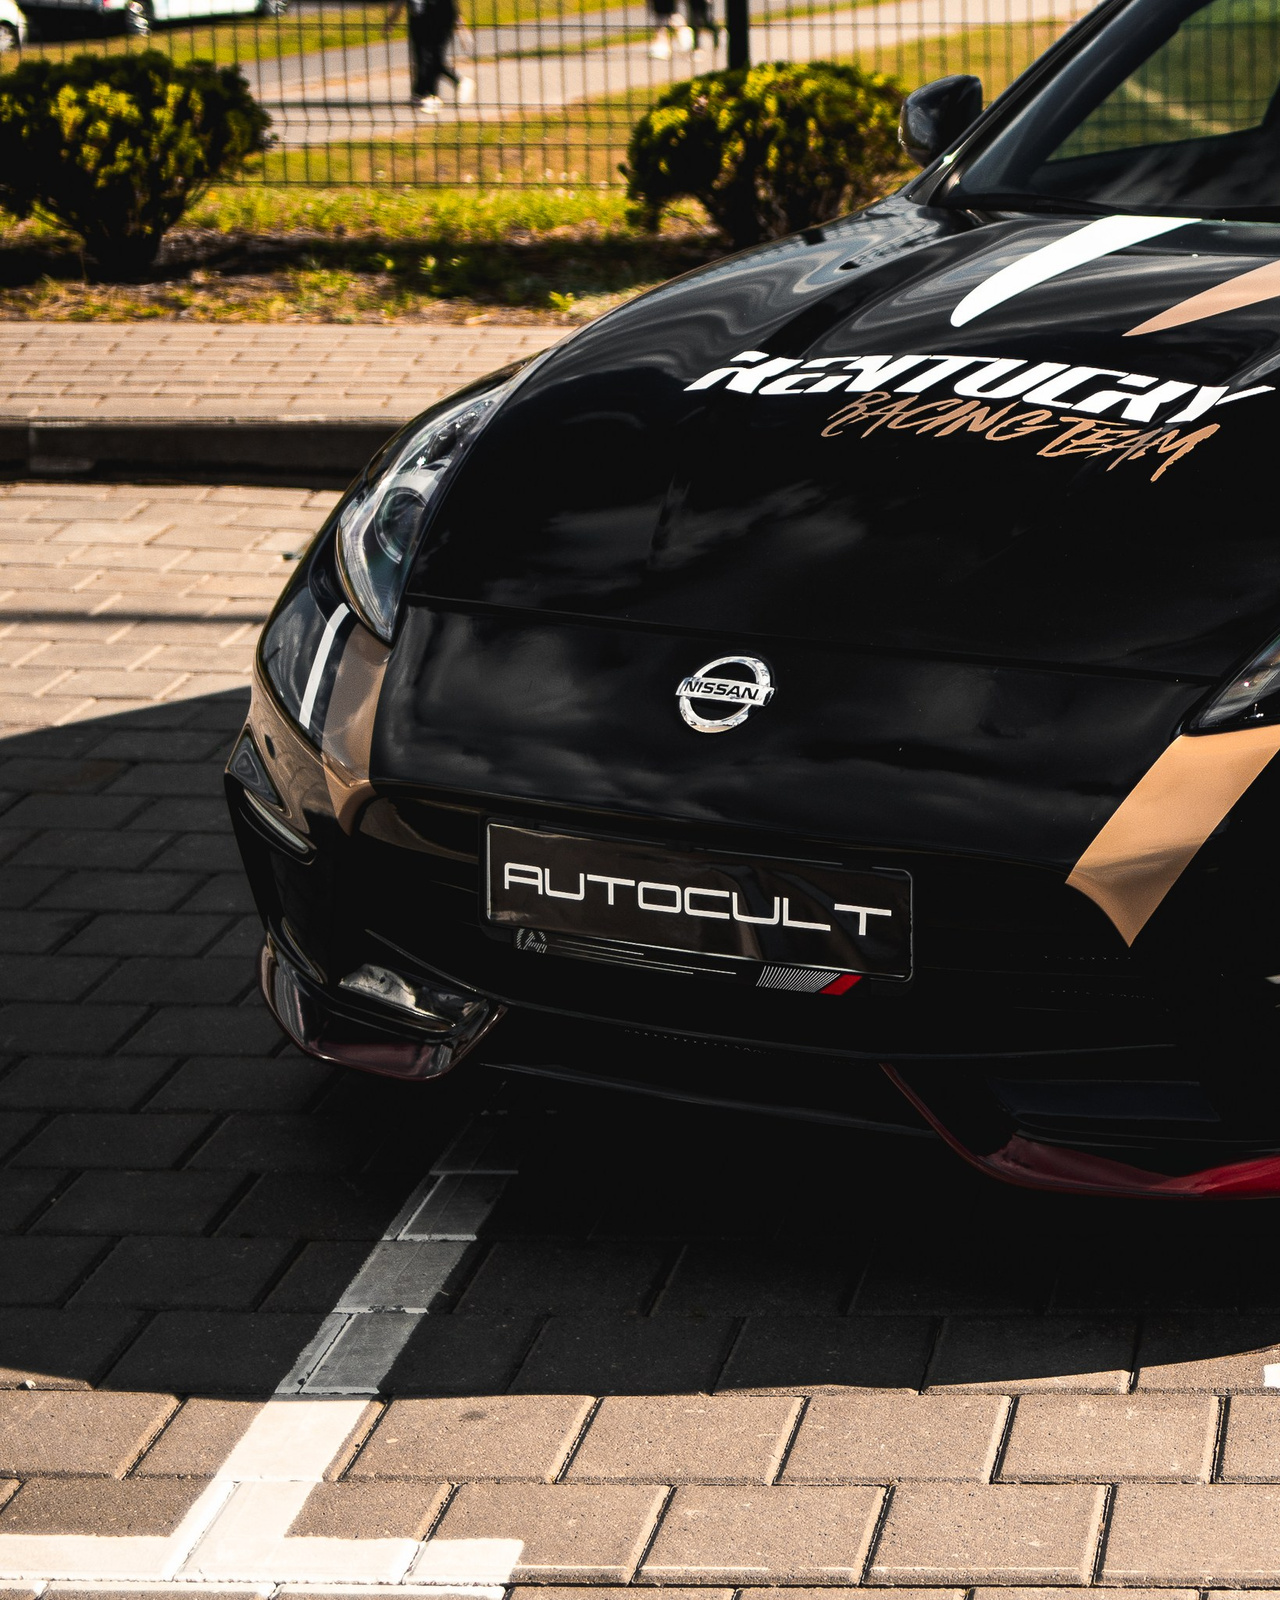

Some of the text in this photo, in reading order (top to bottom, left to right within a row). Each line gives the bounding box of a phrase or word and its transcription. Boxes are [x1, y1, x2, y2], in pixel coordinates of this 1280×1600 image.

[684, 351, 1275, 422] KENTUCKY
[821, 391, 1221, 482] RACING TEAM
[683, 679, 762, 701] NISSAN
[503, 861, 893, 937] AUTOCULT
